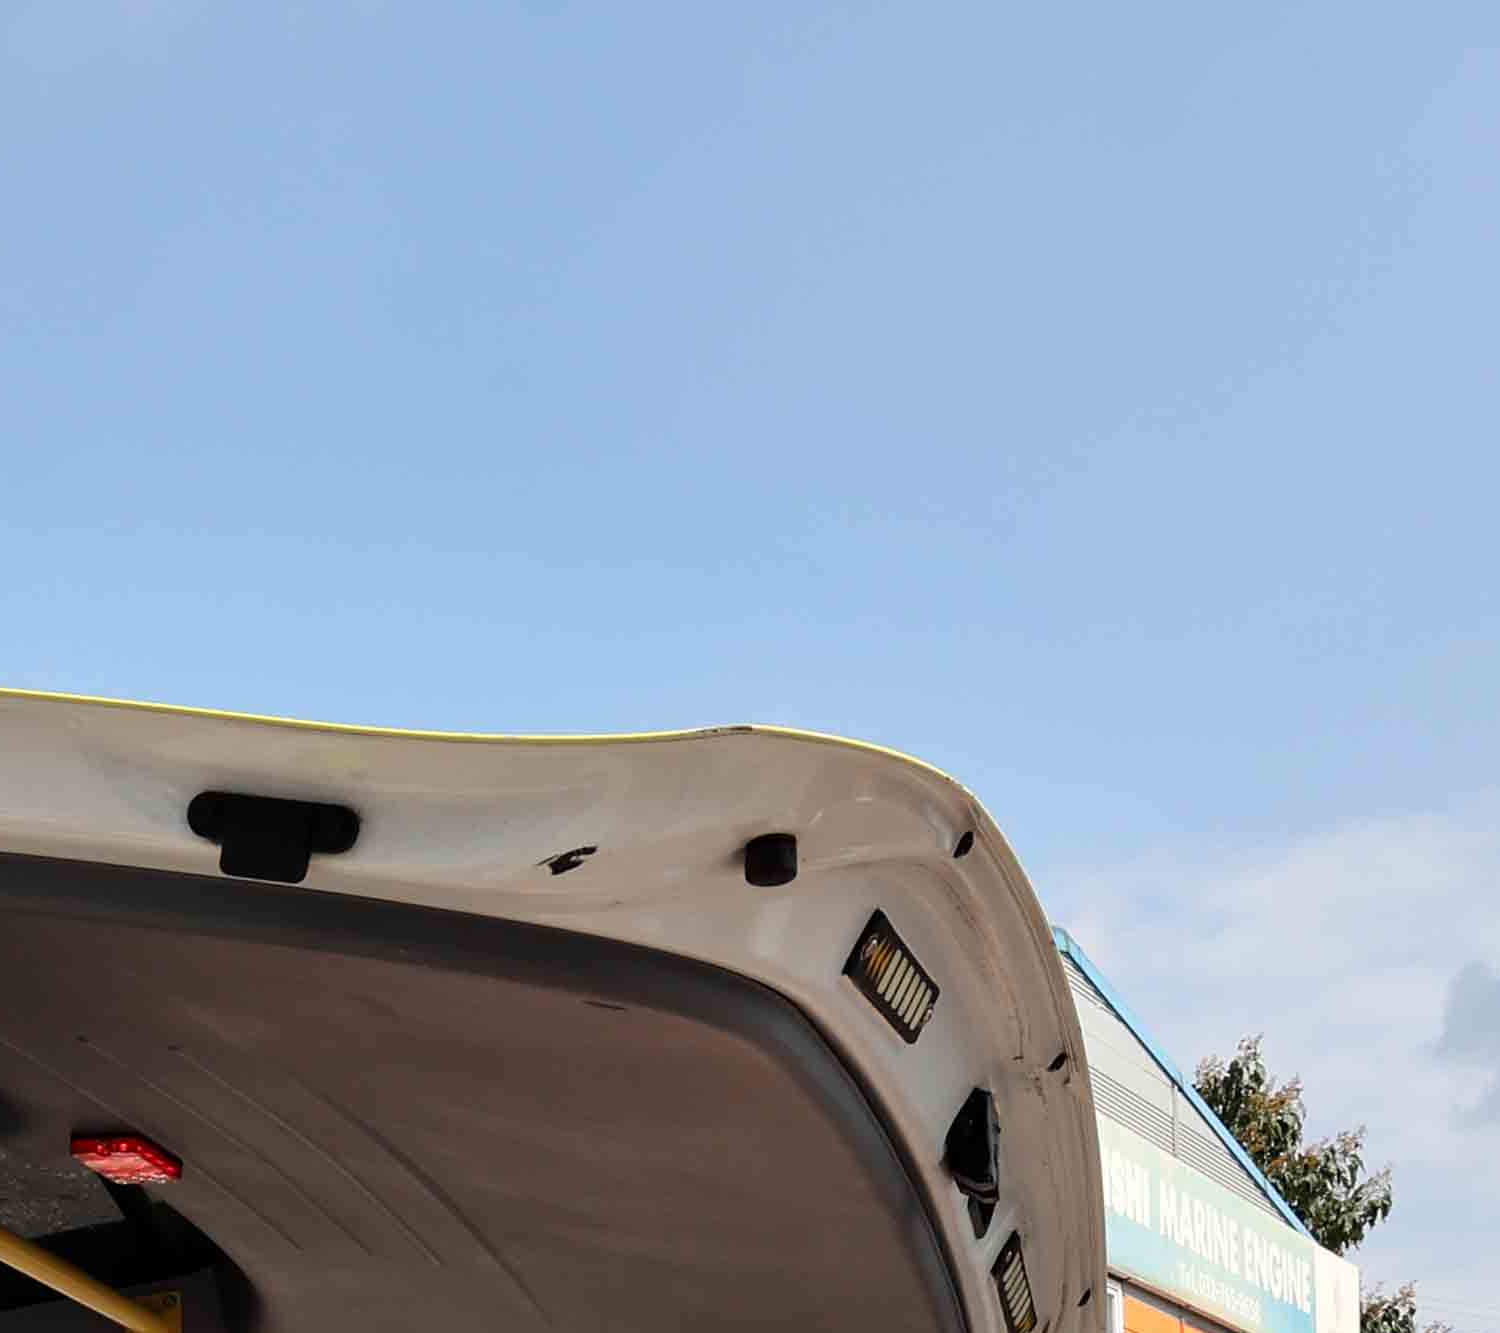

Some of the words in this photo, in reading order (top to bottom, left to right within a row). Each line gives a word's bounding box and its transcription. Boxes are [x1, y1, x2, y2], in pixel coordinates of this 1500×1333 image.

[1104, 1146, 1152, 1231] SHI
[1159, 1177, 1240, 1274] MARINE
[1243, 1227, 1312, 1314] ENGINE
